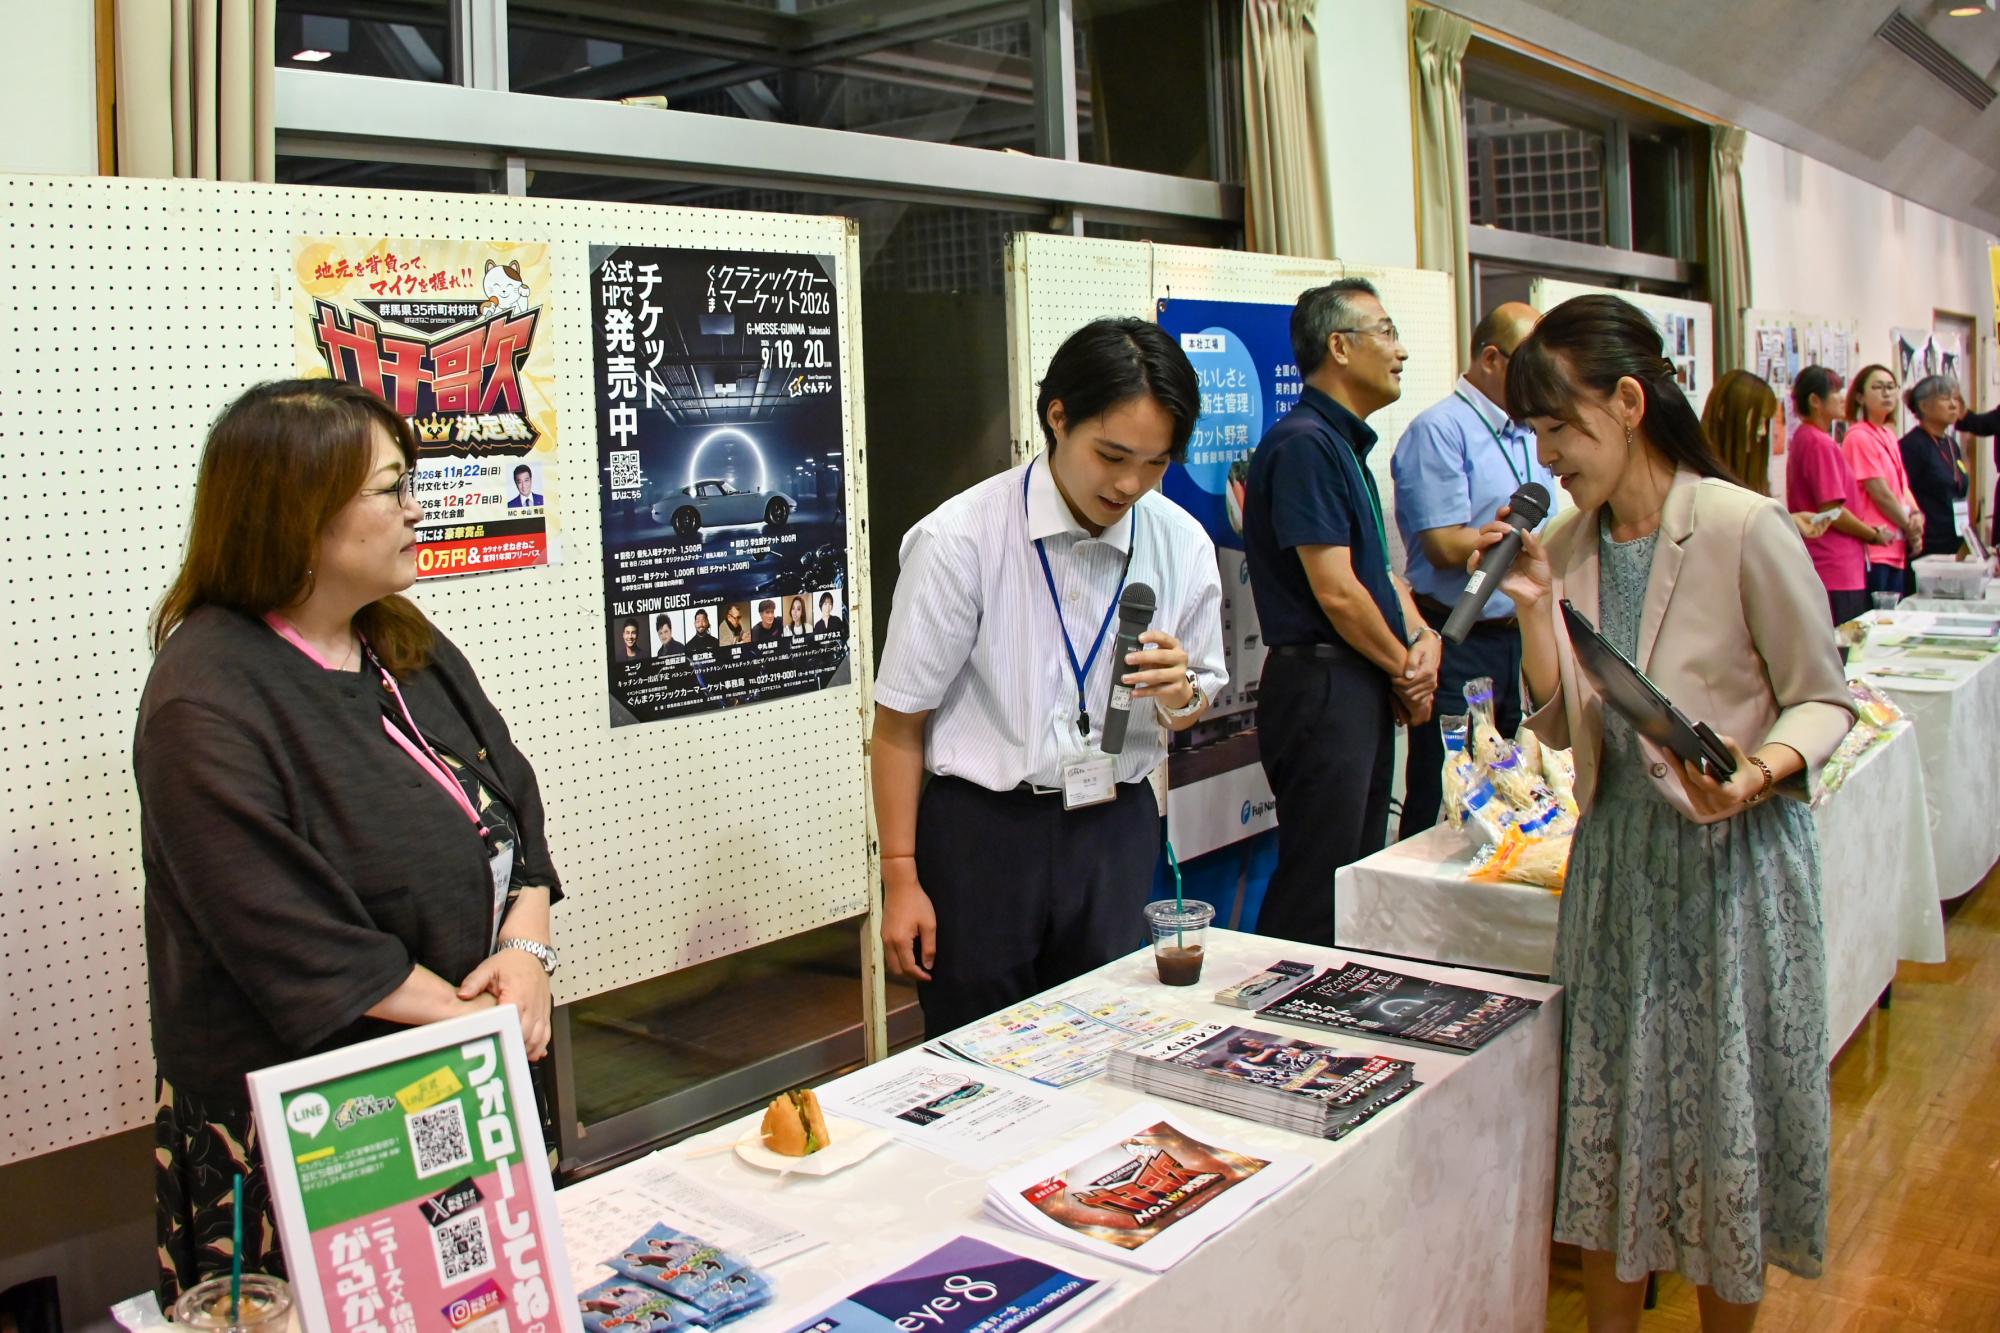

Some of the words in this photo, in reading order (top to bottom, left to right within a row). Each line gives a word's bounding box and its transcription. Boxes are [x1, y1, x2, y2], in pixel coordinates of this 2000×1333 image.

[601, 260, 634, 283] 公式
[718, 265, 829, 292] クラシックカー
[707, 264, 717, 314] ぐんま
[379, 303, 479, 317] 群馬県35市町村対抗
[719, 290, 830, 315] マーケット2026
[636, 263, 667, 409] チケット
[746, 322, 806, 335] G-MESSE-GUNMA
[1188, 338, 1219, 350] 本社工場
[313, 303, 536, 415] ガチ歌
[604, 309, 638, 447] 発売中
[803, 382, 833, 394] ぐんテレ
[780, 533, 797, 543] 800円
[612, 601, 634, 616] TALK
[636, 598, 661, 613] SHOW
[664, 593, 692, 610] GUEST
[292, 1103, 324, 1123] LINE
[460, 1038, 551, 1325] フォローしてね
[1134, 1199, 1173, 1225] No.1
